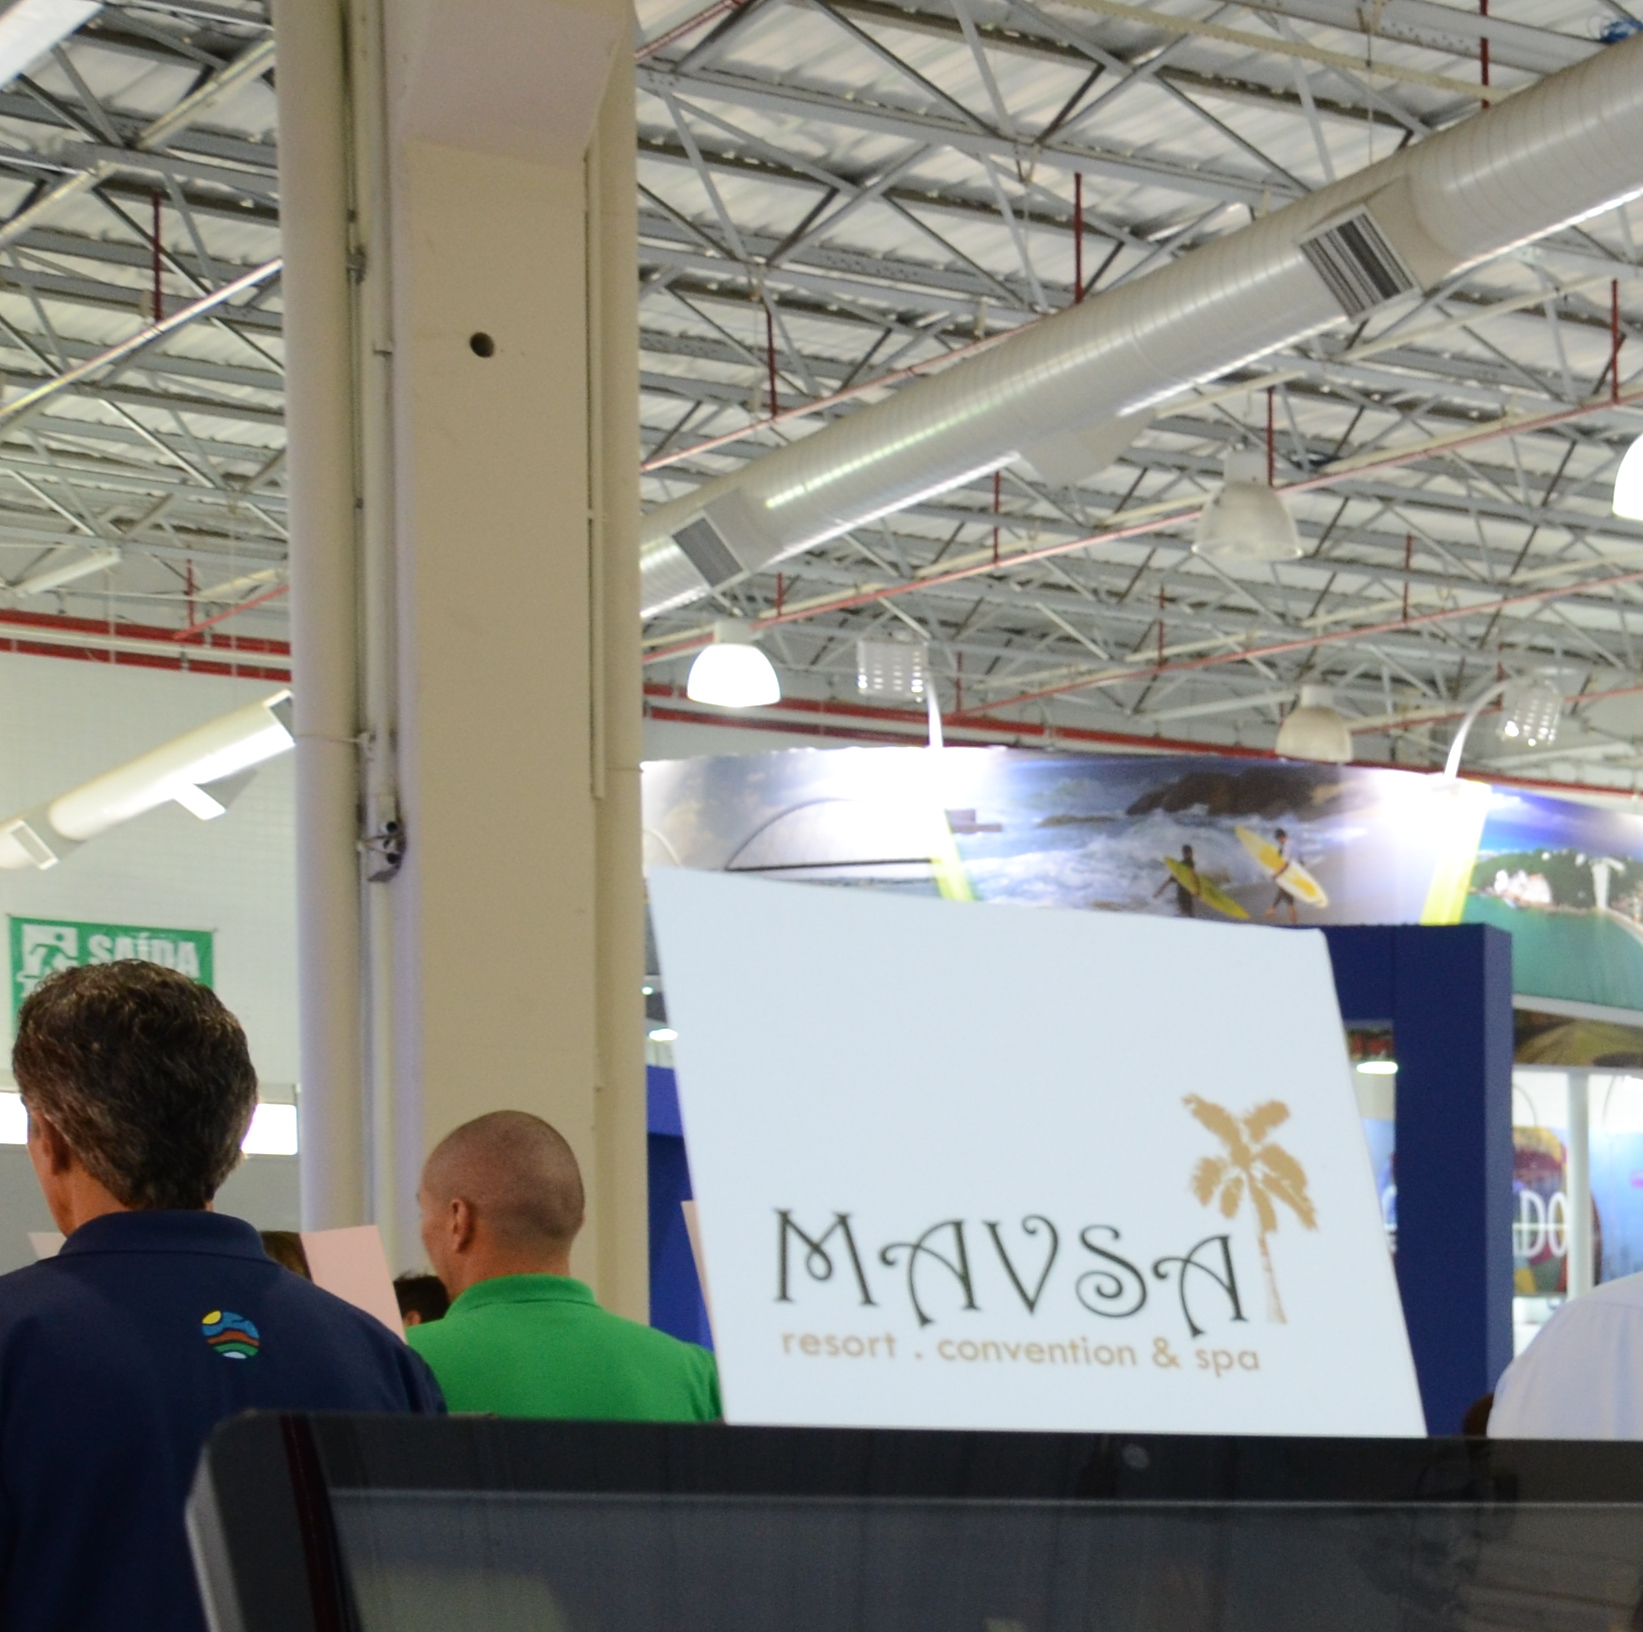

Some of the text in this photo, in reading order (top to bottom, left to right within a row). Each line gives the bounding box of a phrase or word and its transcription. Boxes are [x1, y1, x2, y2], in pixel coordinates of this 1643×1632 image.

[774, 1208, 1249, 1338] MAVSA
[782, 1331, 896, 1360] resort
[937, 1335, 1137, 1368] convention
[1152, 1337, 1180, 1369] &
[1196, 1344, 1261, 1377] spa
